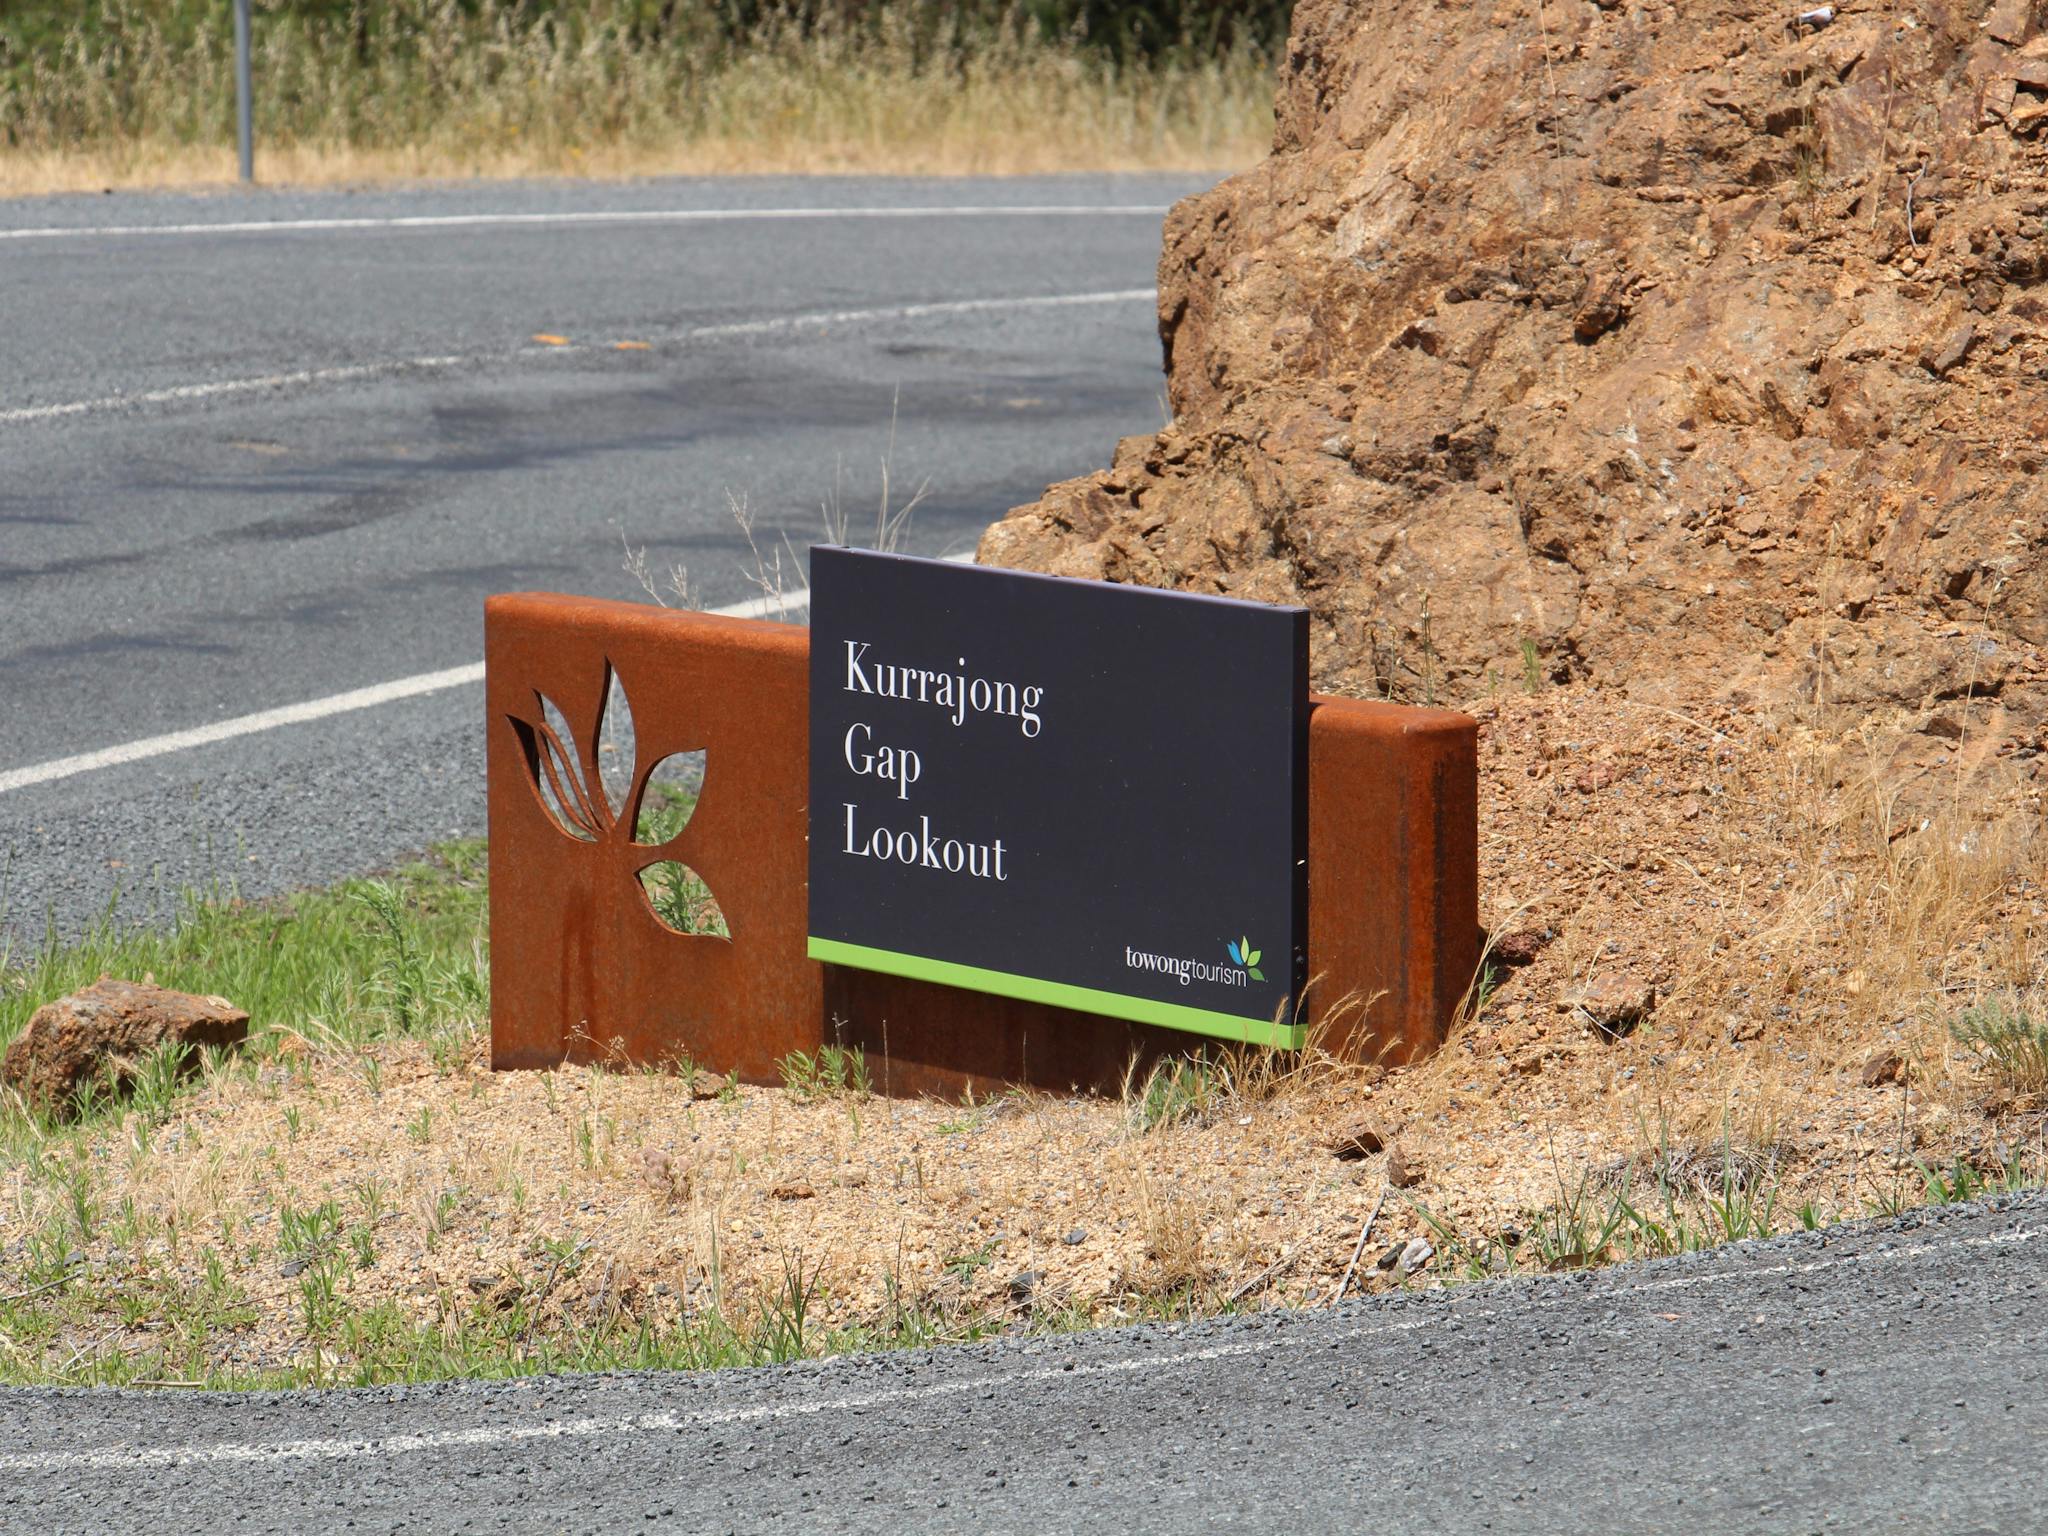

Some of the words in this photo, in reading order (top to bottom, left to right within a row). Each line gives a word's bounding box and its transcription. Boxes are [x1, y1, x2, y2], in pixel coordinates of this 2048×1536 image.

[843, 640, 1044, 738] Kurrajong
[844, 722, 921, 800] Gap
[843, 803, 1007, 881] Lookout
